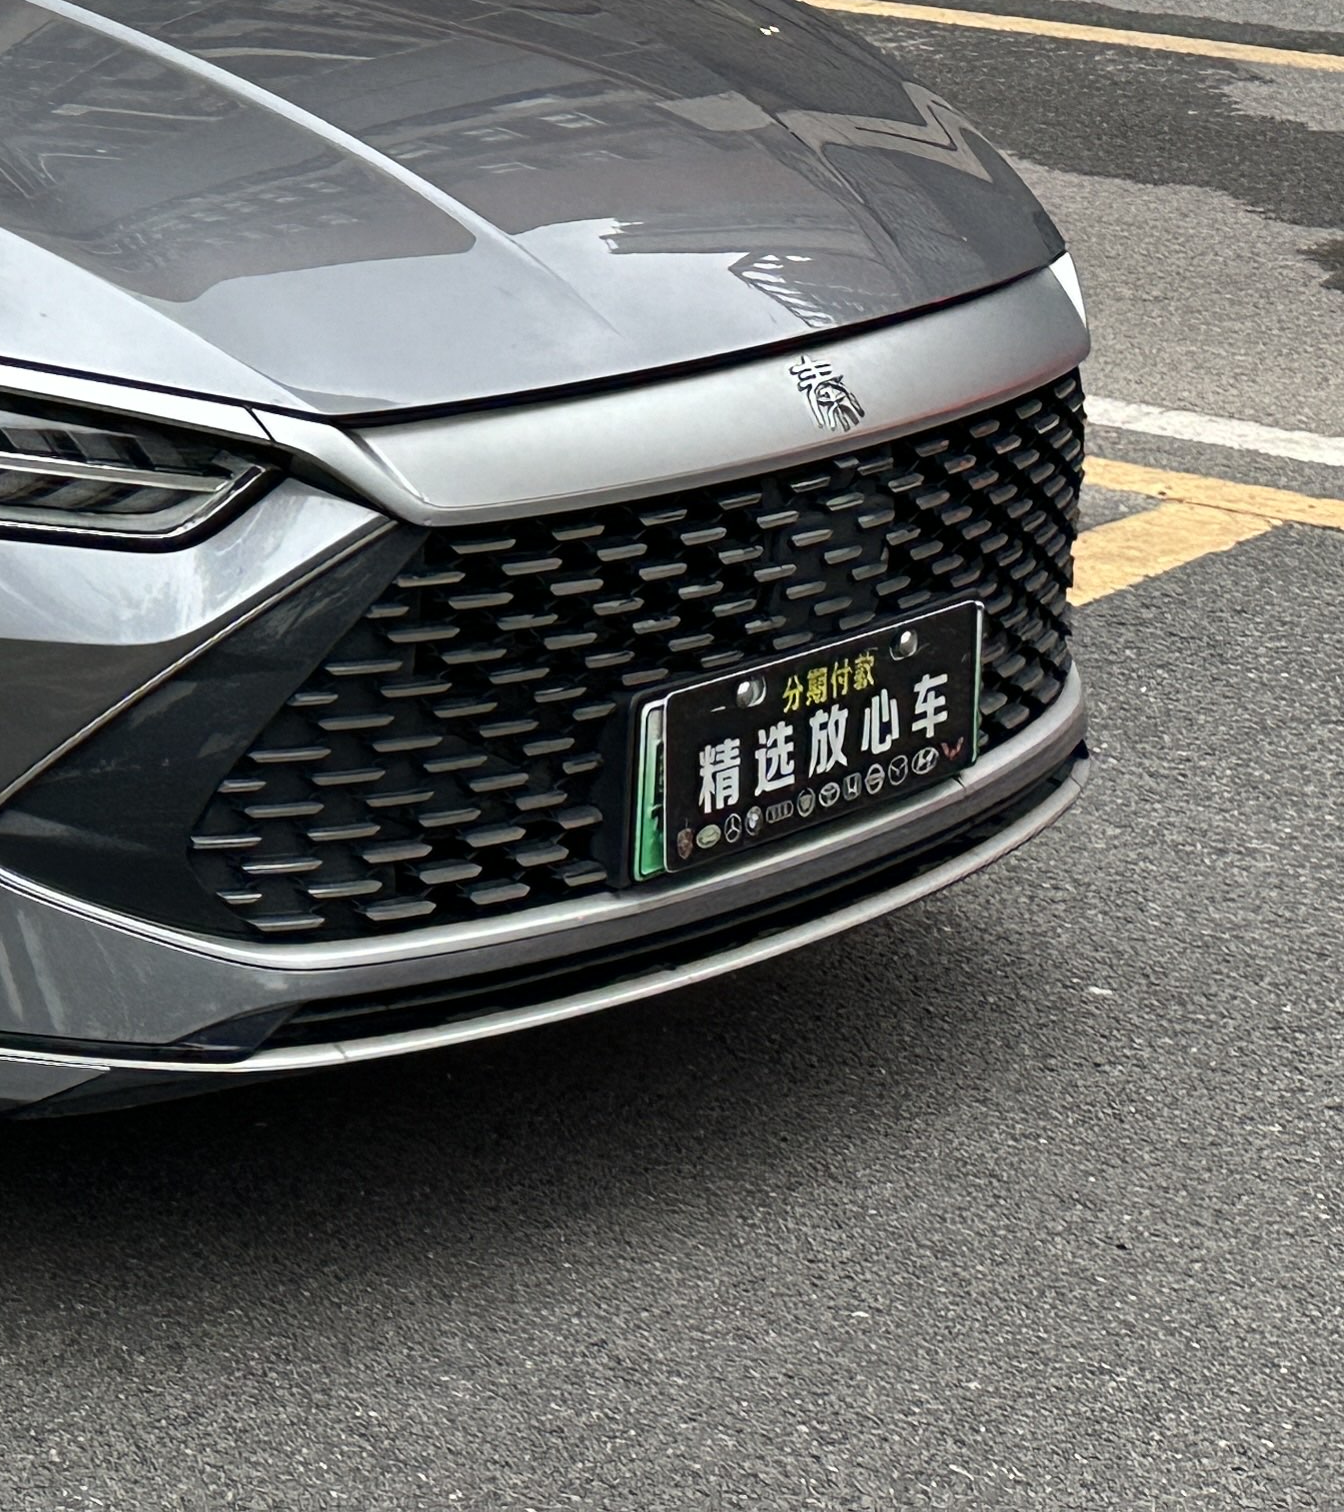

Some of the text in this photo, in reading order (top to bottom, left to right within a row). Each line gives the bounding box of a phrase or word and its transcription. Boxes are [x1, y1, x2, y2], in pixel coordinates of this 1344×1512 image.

[782, 654, 876, 713] 分期付款
[698, 673, 949, 814] 精选放心车
